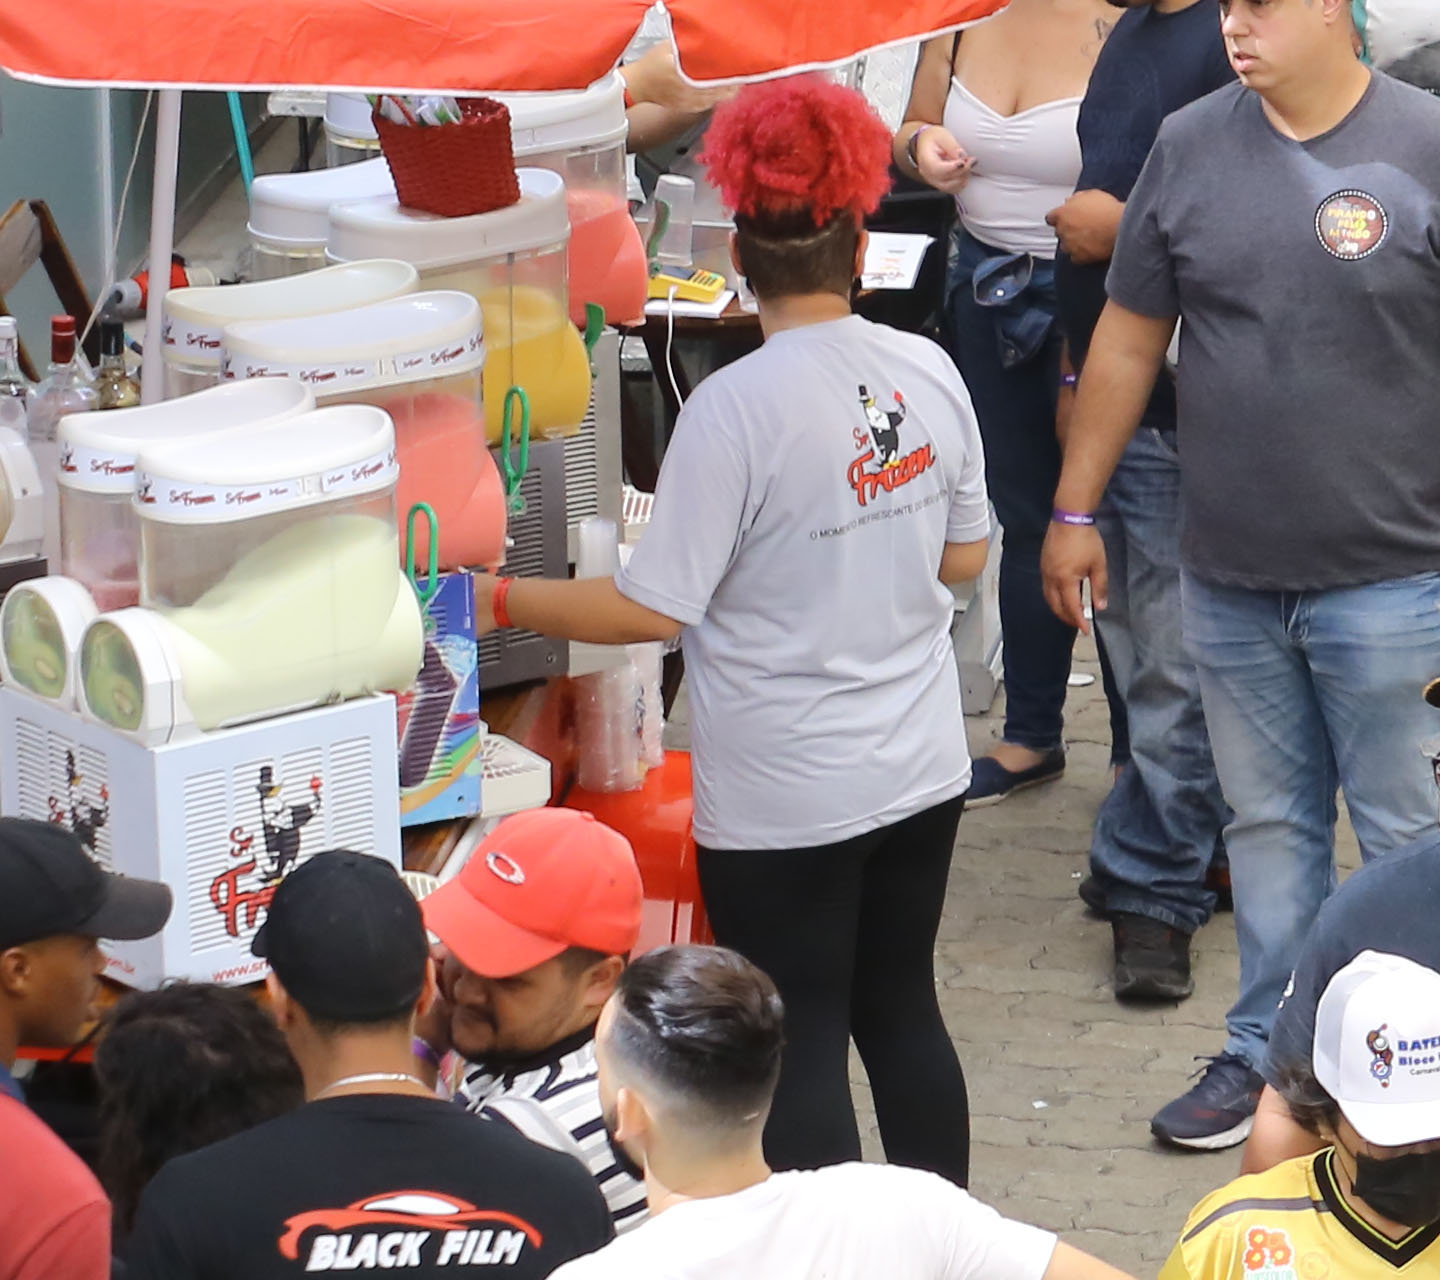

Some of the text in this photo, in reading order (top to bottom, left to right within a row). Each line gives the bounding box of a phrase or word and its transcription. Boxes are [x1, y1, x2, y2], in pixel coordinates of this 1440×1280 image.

[848, 443, 937, 507] Frozen
[810, 529, 818, 541] O
[1398, 1055, 1435, 1066] Bloco
[305, 1229, 527, 1272] BLACK FILM
